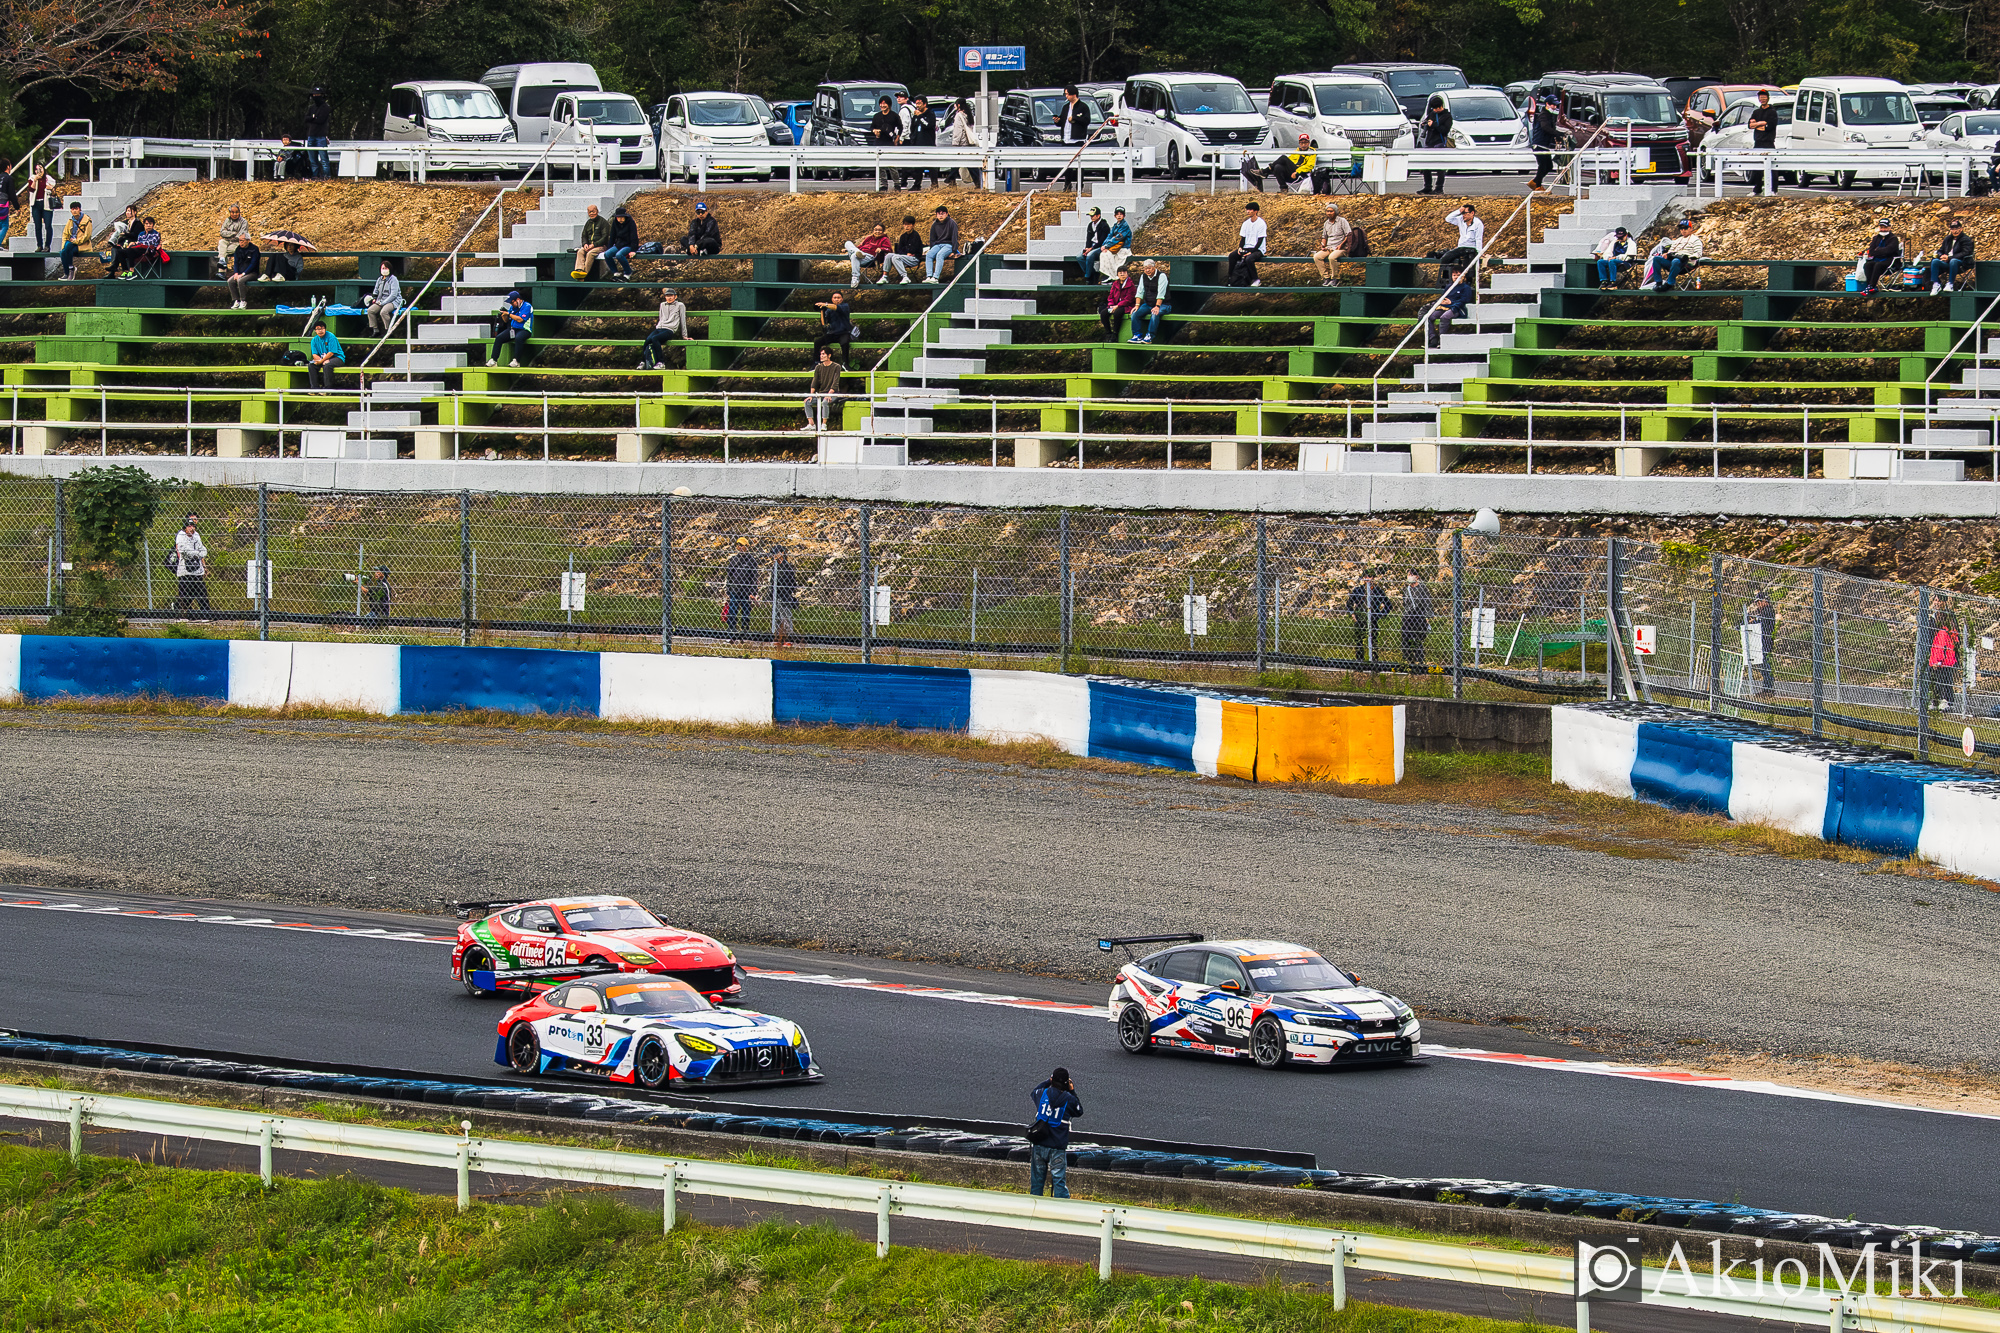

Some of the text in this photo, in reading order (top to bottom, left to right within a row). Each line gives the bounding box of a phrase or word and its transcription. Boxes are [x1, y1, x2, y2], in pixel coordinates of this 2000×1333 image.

[509, 941, 544, 959] raffinée
[546, 946, 563, 967] 25
[519, 957, 544, 967] NISSAN
[1258, 967, 1278, 977] 96
[1180, 1000, 1195, 1012] SKY
[1227, 1006, 1244, 1029] 96
[548, 1024, 584, 1042] proton
[586, 1024, 603, 1047] 33
[1355, 1041, 1402, 1053] CIVIC
[1040, 1102, 1061, 1119] 151
